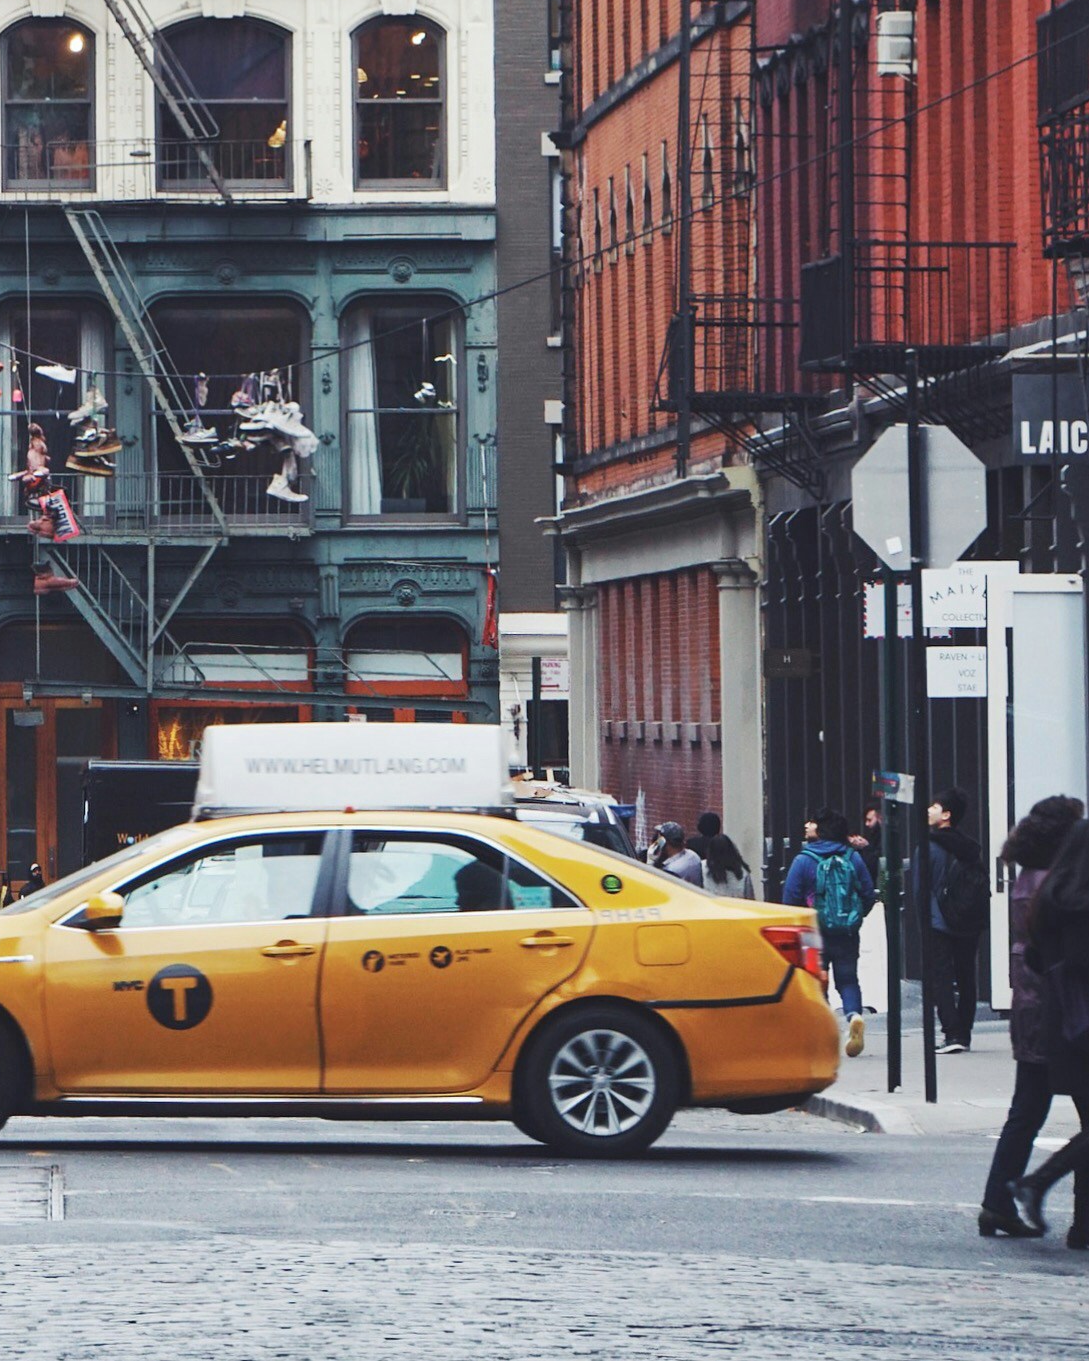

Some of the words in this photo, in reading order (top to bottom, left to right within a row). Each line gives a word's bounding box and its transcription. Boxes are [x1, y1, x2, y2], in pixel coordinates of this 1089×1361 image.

[1021, 421, 1088, 454] LAIC
[958, 567, 974, 576] THE
[783, 655, 791, 663] H
[939, 652, 968, 661] RAVEN
[245, 757, 467, 776] WWW.HELMUTLANG.COM
